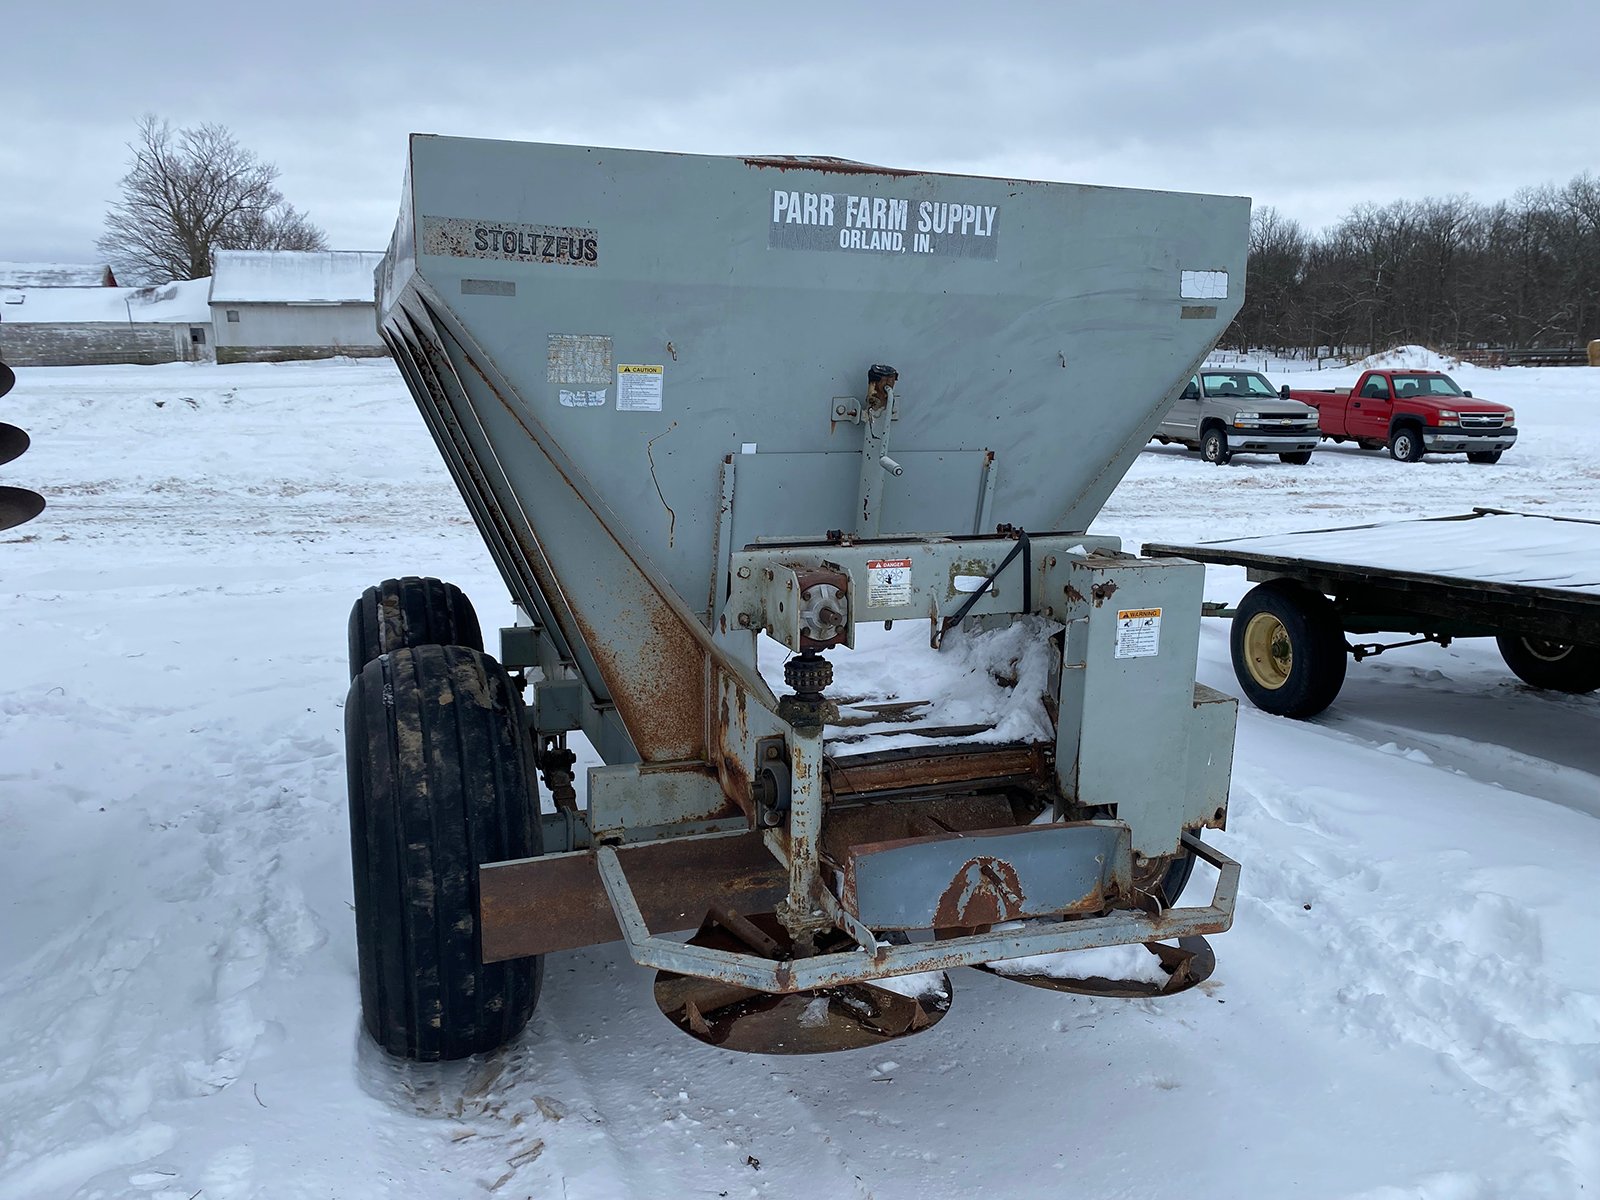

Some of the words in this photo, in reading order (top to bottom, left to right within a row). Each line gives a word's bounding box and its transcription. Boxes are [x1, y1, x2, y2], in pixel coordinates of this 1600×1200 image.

[773, 190, 835, 226] PARR
[846, 195, 908, 231] FARM
[917, 200, 997, 237] SUPPLY
[839, 229, 906, 254] ORLAND,
[913, 233, 934, 253] IN.
